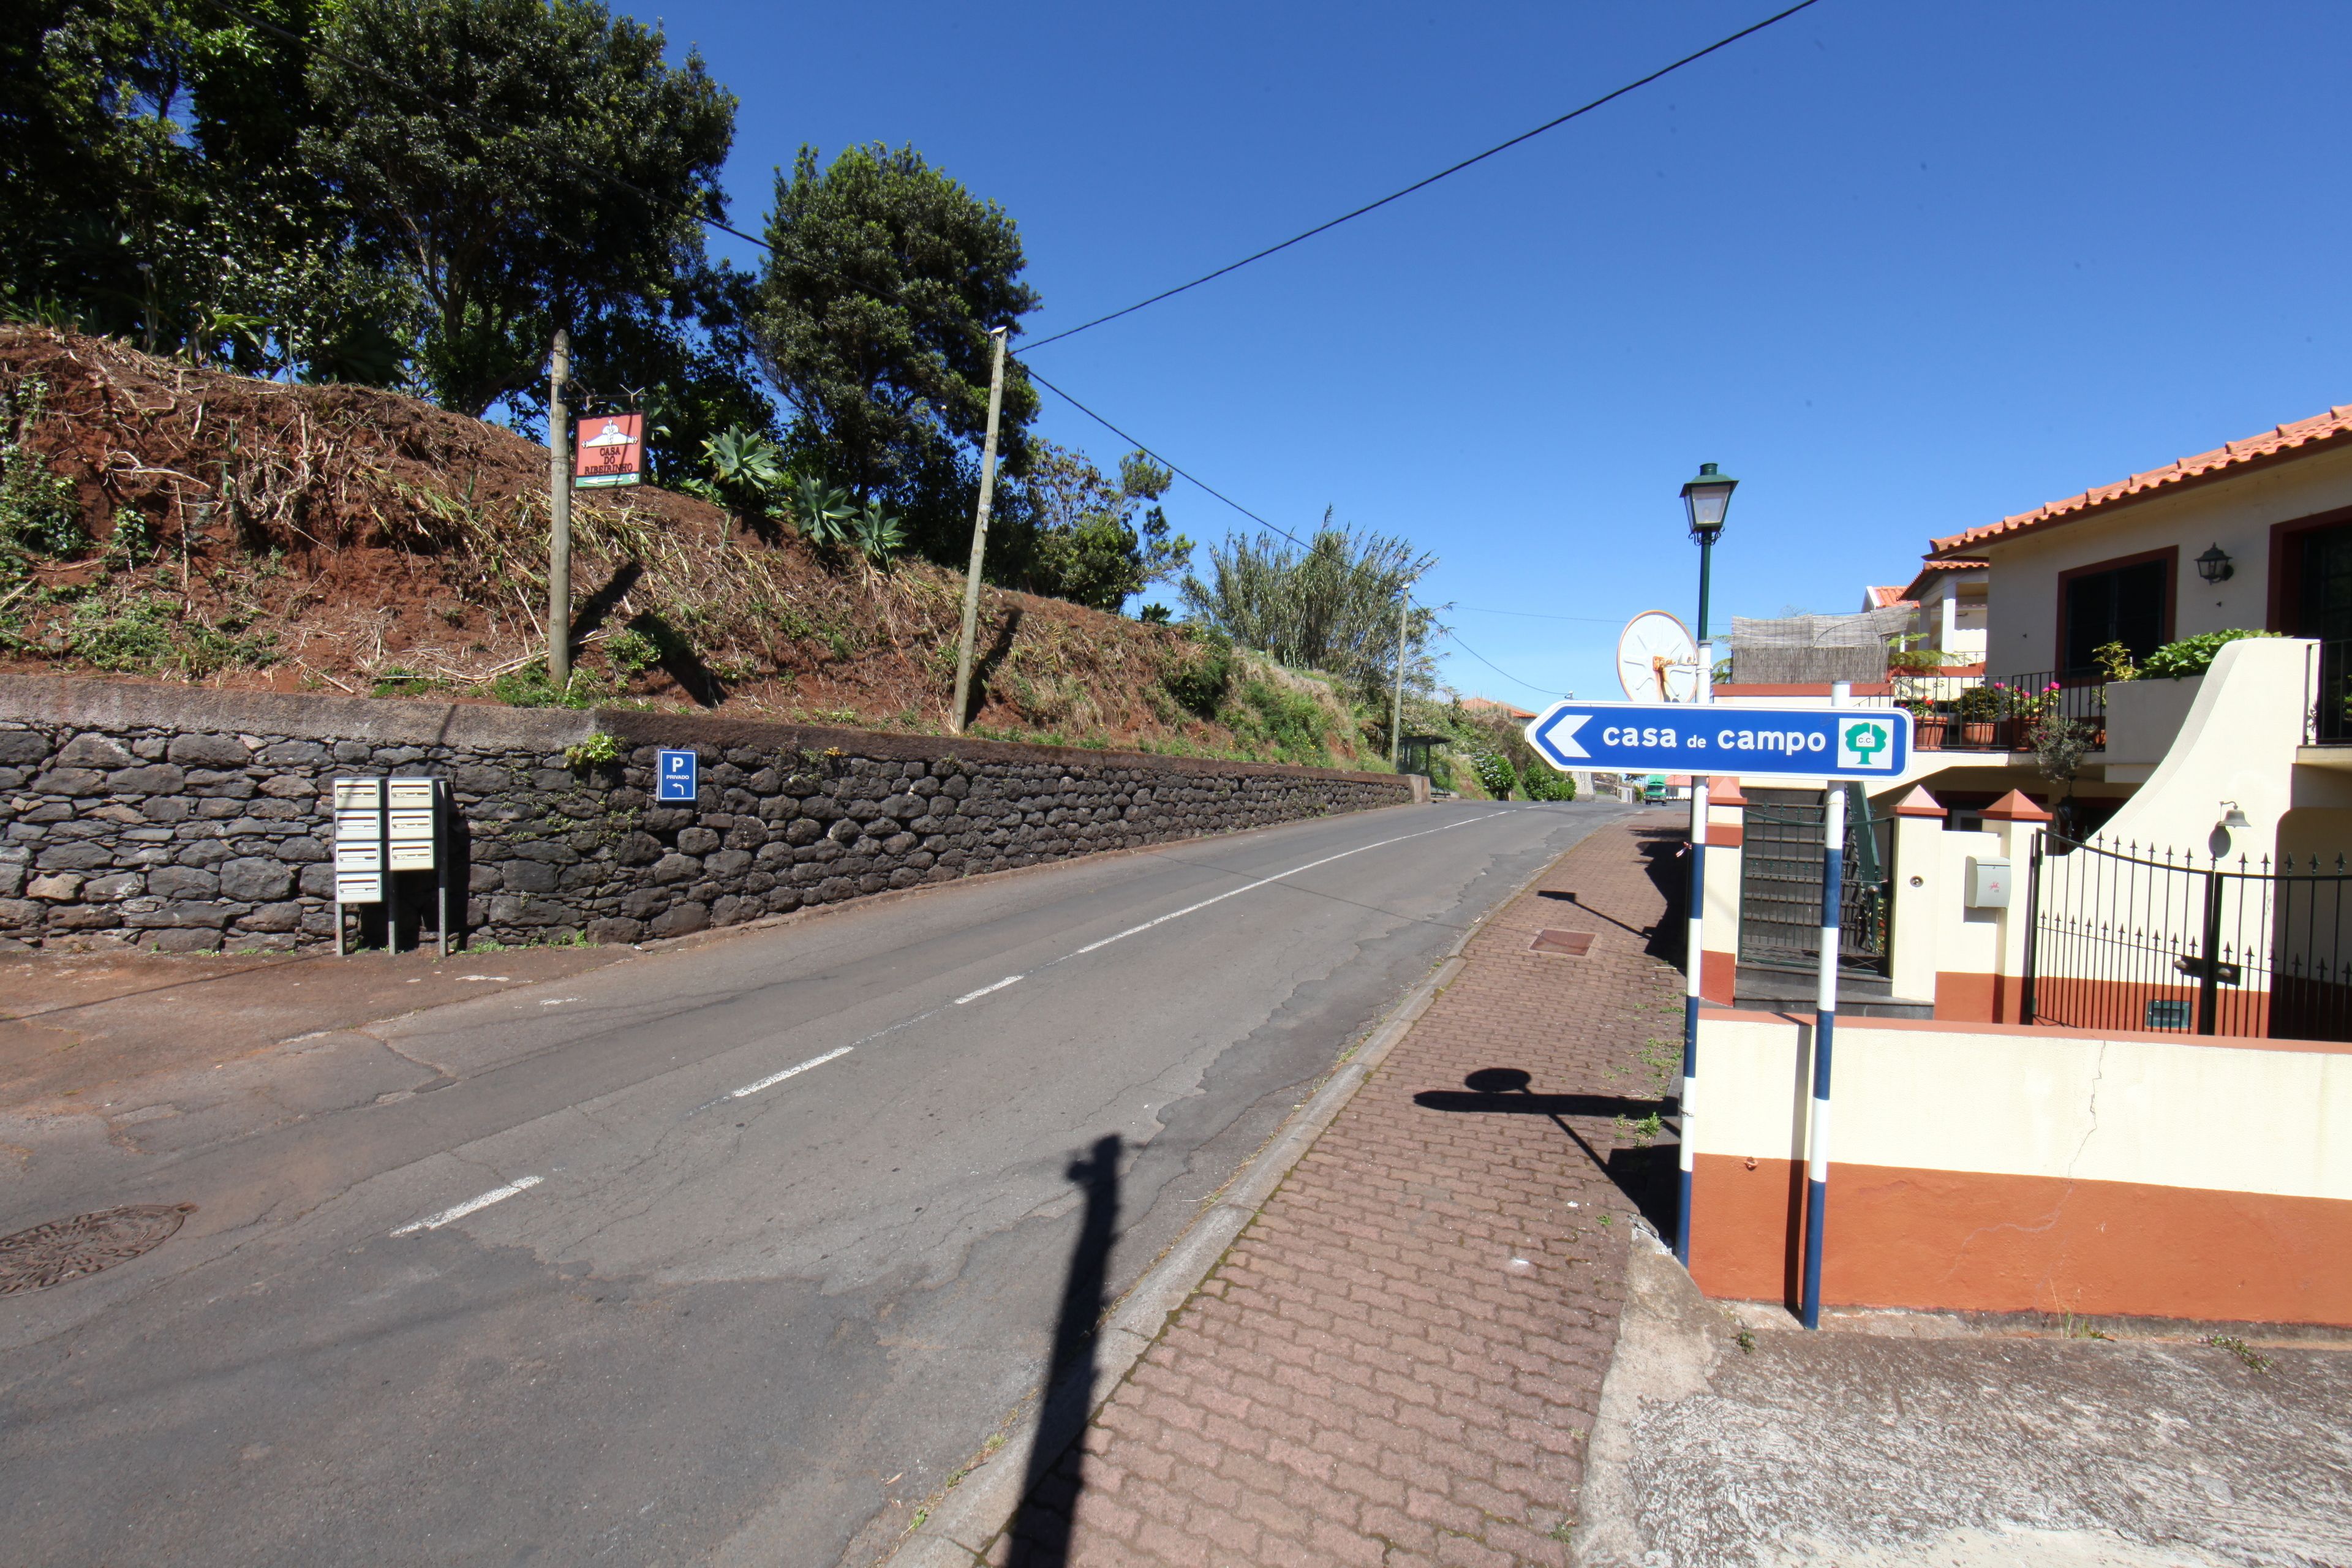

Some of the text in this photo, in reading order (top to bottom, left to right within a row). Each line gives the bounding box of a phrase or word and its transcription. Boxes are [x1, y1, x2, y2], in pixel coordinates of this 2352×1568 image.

[600, 447, 620, 456] CASA
[584, 463, 633, 475] RIBEIRINHO
[1603, 727, 1826, 755] casa de campo
[673, 757, 684, 772] P
